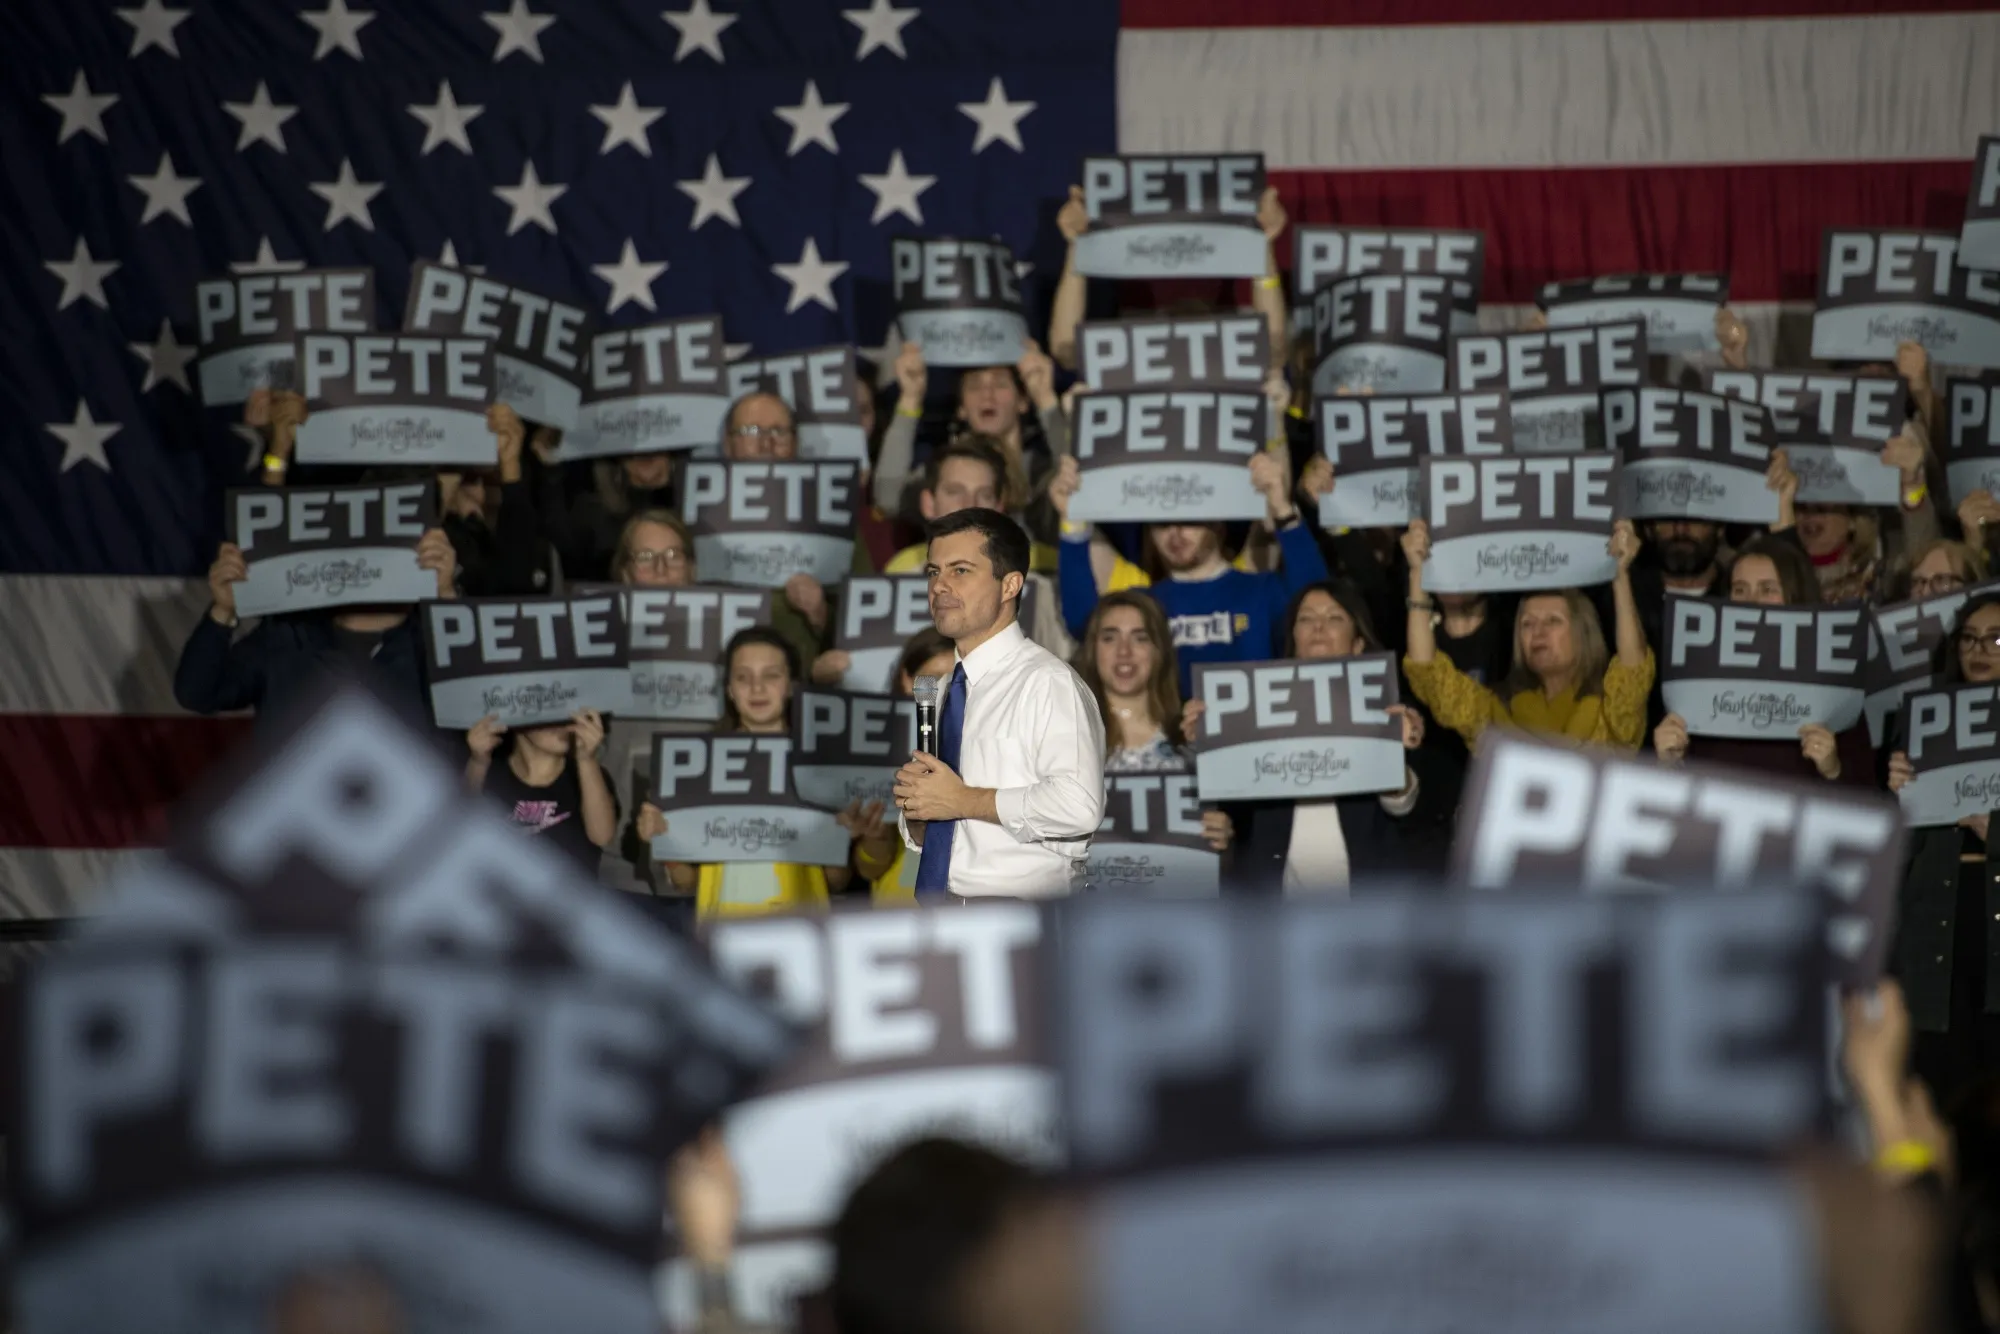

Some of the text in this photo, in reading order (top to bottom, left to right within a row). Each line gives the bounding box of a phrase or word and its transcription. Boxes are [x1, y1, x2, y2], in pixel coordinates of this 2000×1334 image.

[1084, 158, 1258, 220] PETE
[893, 240, 1022, 300] PETE
[199, 273, 369, 343] PETE
[413, 266, 587, 369] PETE
[1314, 275, 1445, 354] PETE
[304, 336, 488, 399] PETE
[592, 321, 720, 391] ETE
[728, 352, 852, 414] ETE
[1083, 318, 1264, 390] PETE
[1457, 325, 1641, 391] PETE
[1079, 393, 1259, 459] PETE
[1322, 394, 1503, 465] PETE
[1604, 388, 1771, 460] PETE
[235, 484, 426, 551] PETE
[684, 463, 855, 525] PETE
[1430, 456, 1615, 528] PETE
[430, 598, 615, 668] PETE
[630, 590, 762, 650] ETE
[845, 579, 934, 639] PE
[1671, 599, 1860, 673] PETE
[803, 692, 917, 755] PET
[1203, 660, 1390, 737] PETE
[1908, 686, 2000, 759] PE
[660, 738, 792, 797] PET
[1103, 775, 1203, 835] TE
[1470, 742, 1890, 955] PETE
[712, 903, 1042, 1064] PET
[1072, 898, 1815, 1162] PETE
[25, 943, 668, 1226] PETE
